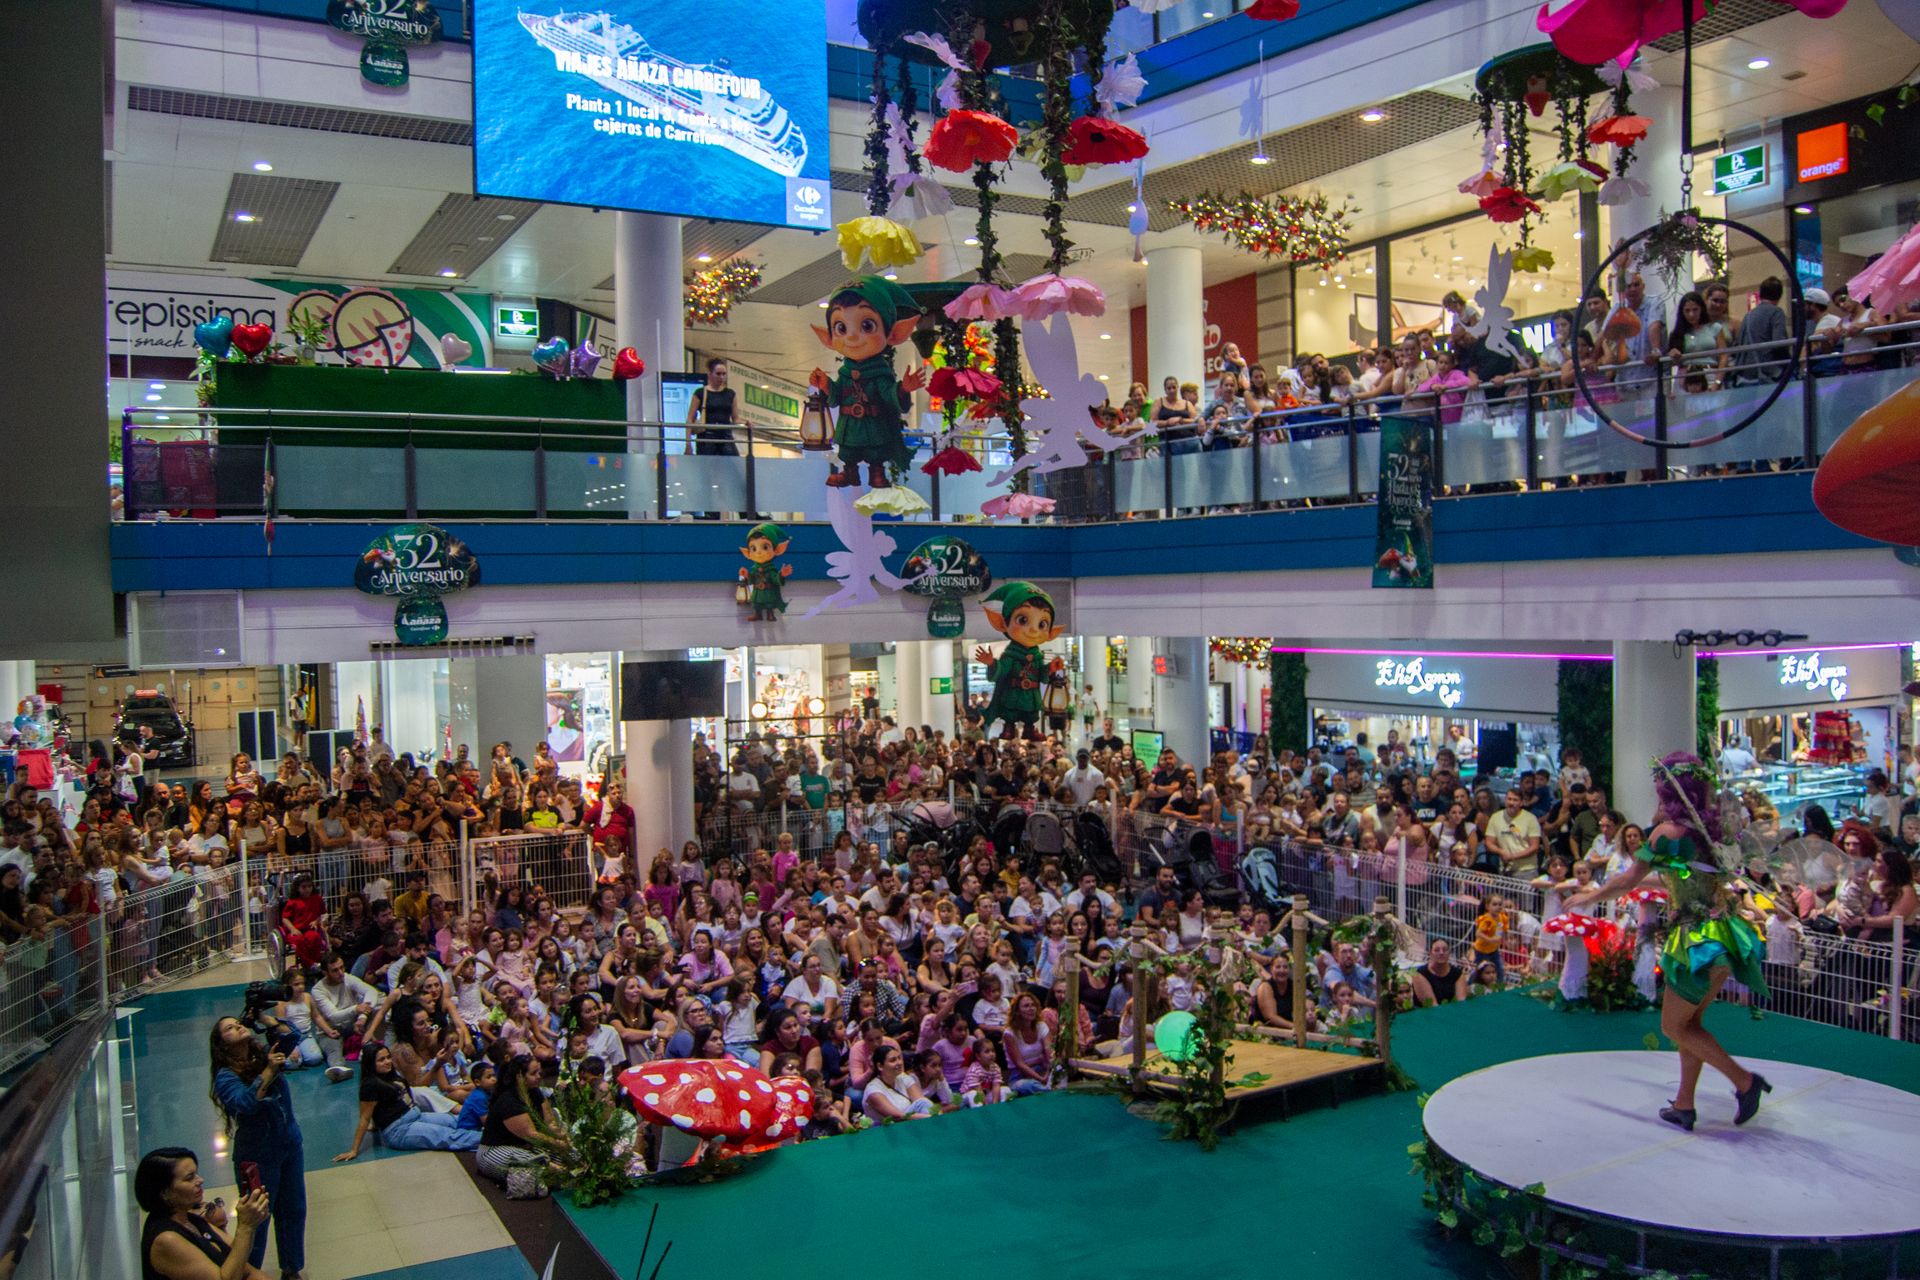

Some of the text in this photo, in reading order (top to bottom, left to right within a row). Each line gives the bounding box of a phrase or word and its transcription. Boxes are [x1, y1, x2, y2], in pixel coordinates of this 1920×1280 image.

[341, 10, 428, 39] Aniversario
[555, 50, 761, 100] VIAJES AÑAZA CARREFOUR
[566, 93, 611, 114] Planta
[615, 100, 623, 115] 1
[627, 102, 660, 120] local
[593, 117, 726, 146] cajeros de Carrefour
[1800, 161, 1841, 178] orange
[108, 296, 276, 332] epissima
[134, 329, 189, 348] snack
[1388, 453, 1409, 481] 32
[394, 533, 441, 569] 32
[930, 544, 964, 575] 32
[370, 567, 464, 595] Aniversario
[914, 574, 980, 595] Aniversario
